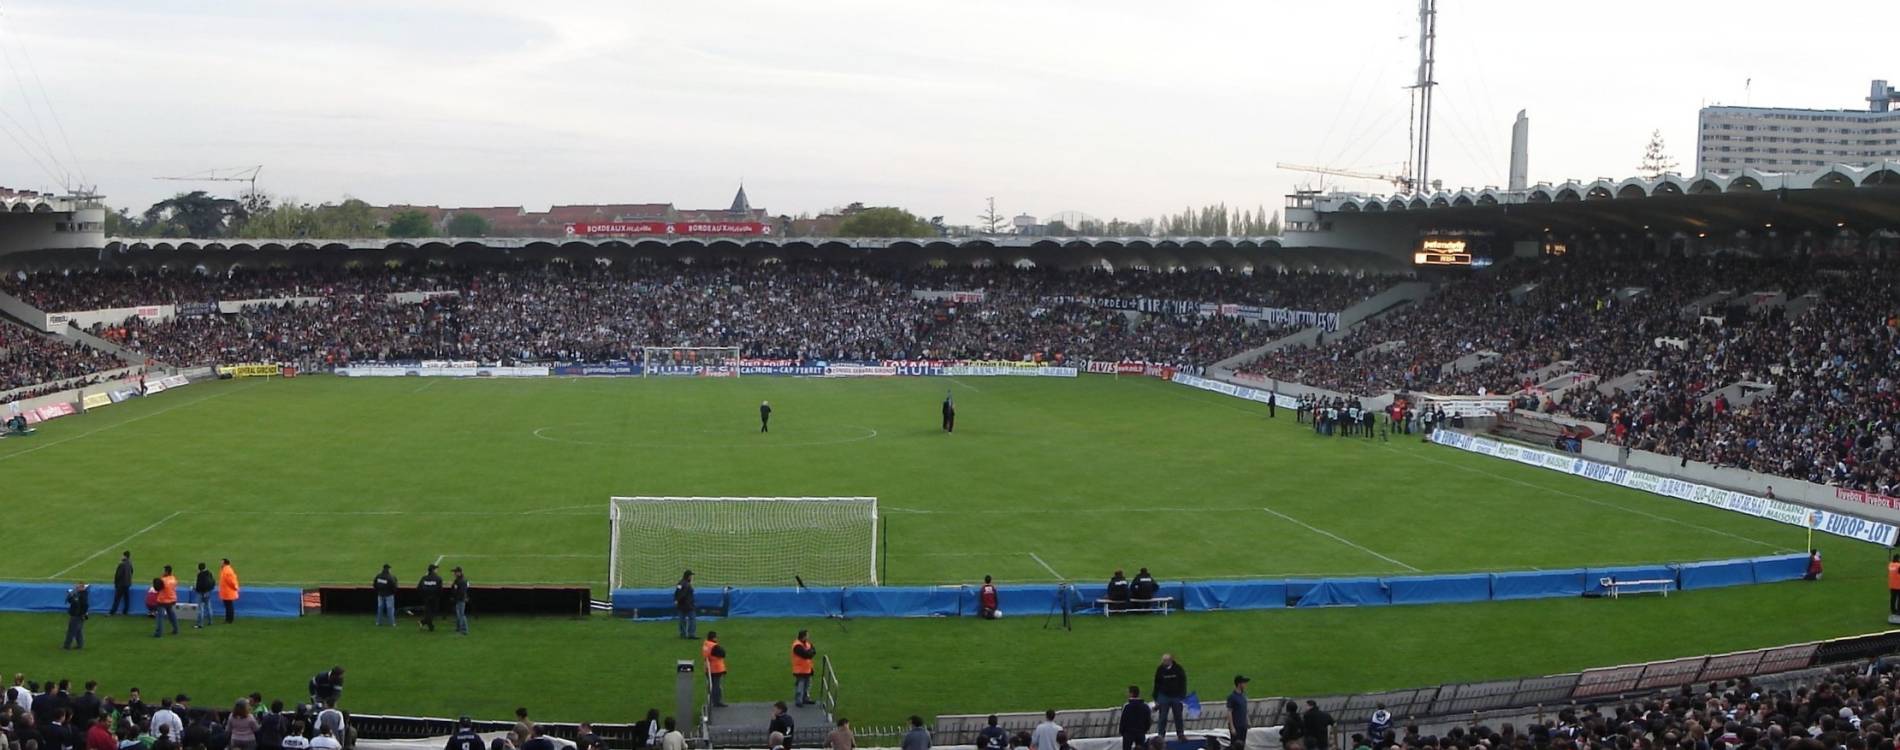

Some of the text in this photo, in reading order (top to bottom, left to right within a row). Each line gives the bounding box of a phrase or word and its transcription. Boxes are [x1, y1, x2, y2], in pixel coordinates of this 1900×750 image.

[587, 225, 626, 233] BORDEAUX
[1090, 363, 1116, 373] AVIS
[1584, 463, 1628, 484] EUROP-LOT
[1769, 500, 1805, 514] TERRAINS
[1766, 510, 1802, 523] MAISONS
[1826, 514, 1892, 543] EUROP-LOT
